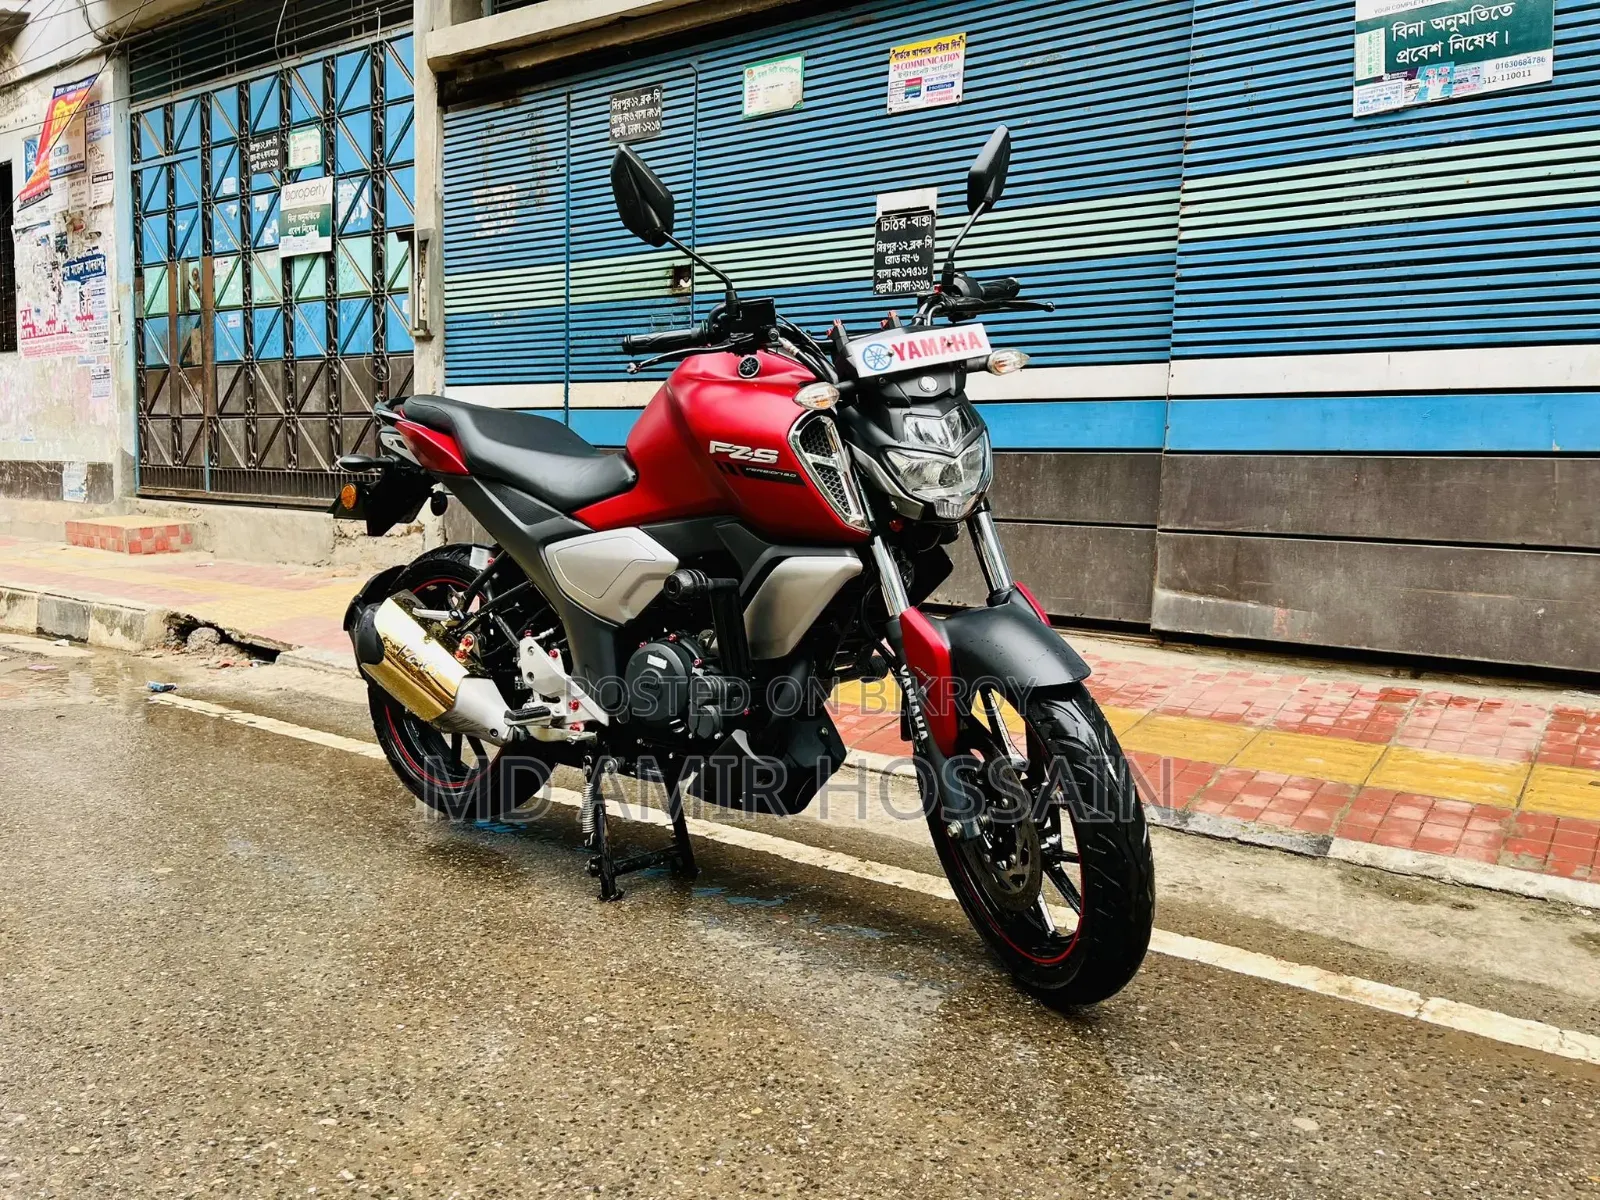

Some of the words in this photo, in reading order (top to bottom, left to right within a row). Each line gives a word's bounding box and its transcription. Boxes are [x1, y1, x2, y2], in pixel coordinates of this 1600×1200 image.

[1391, 21, 1426, 42] বিনা
[1430, 3, 1516, 32] অনুমতিতে
[912, 46, 932, 56] আপনার
[1396, 41, 1444, 64] প্রবেশ
[900, 52, 960, 70] COMMUNICATION
[1495, 56, 1546, 70] 01630684786
[284, 183, 328, 203] bproperty
[884, 254, 900, 265] রোড
[876, 268, 892, 279] বাসা
[892, 332, 982, 361] YAMAHA
[900, 664, 928, 740] YAMAHA
